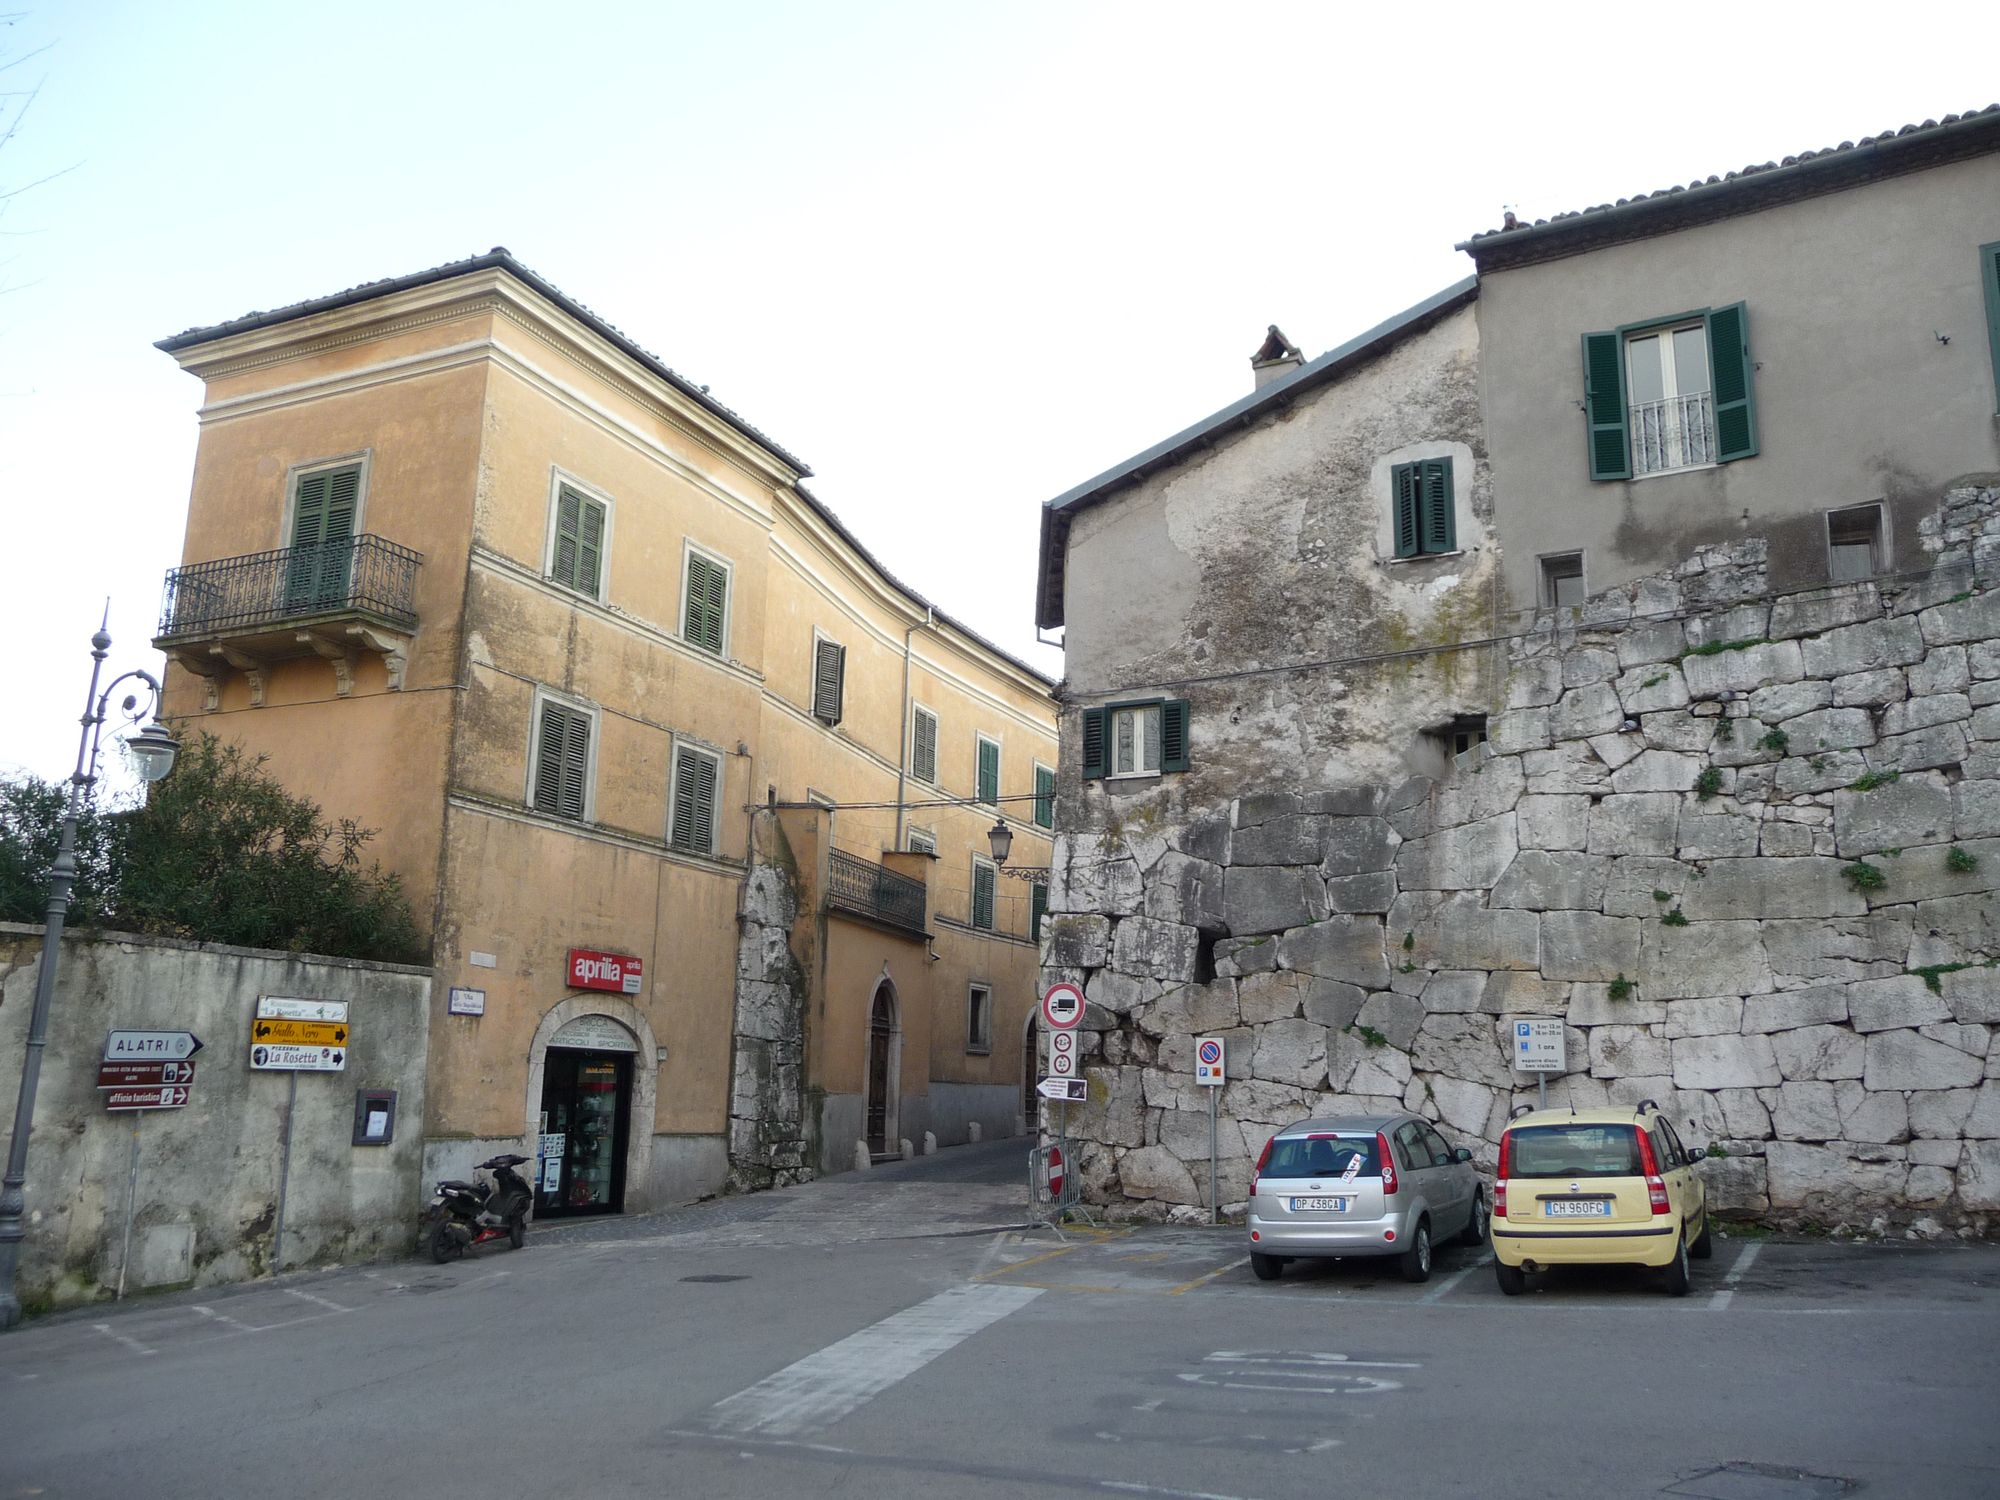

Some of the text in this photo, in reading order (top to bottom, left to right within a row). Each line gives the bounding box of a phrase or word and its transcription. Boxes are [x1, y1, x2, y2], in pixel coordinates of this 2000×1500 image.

[575, 957, 620, 983] aprilia
[116, 1039, 169, 1051] ALATRI
[269, 1052, 280, 1063] La
[282, 1052, 318, 1064] Rosetta
[109, 1092, 132, 1103] ufficio
[133, 1092, 160, 1102] turistico
[1296, 1199, 1339, 1209] DP 438GA
[1552, 1202, 1566, 1214] CH
